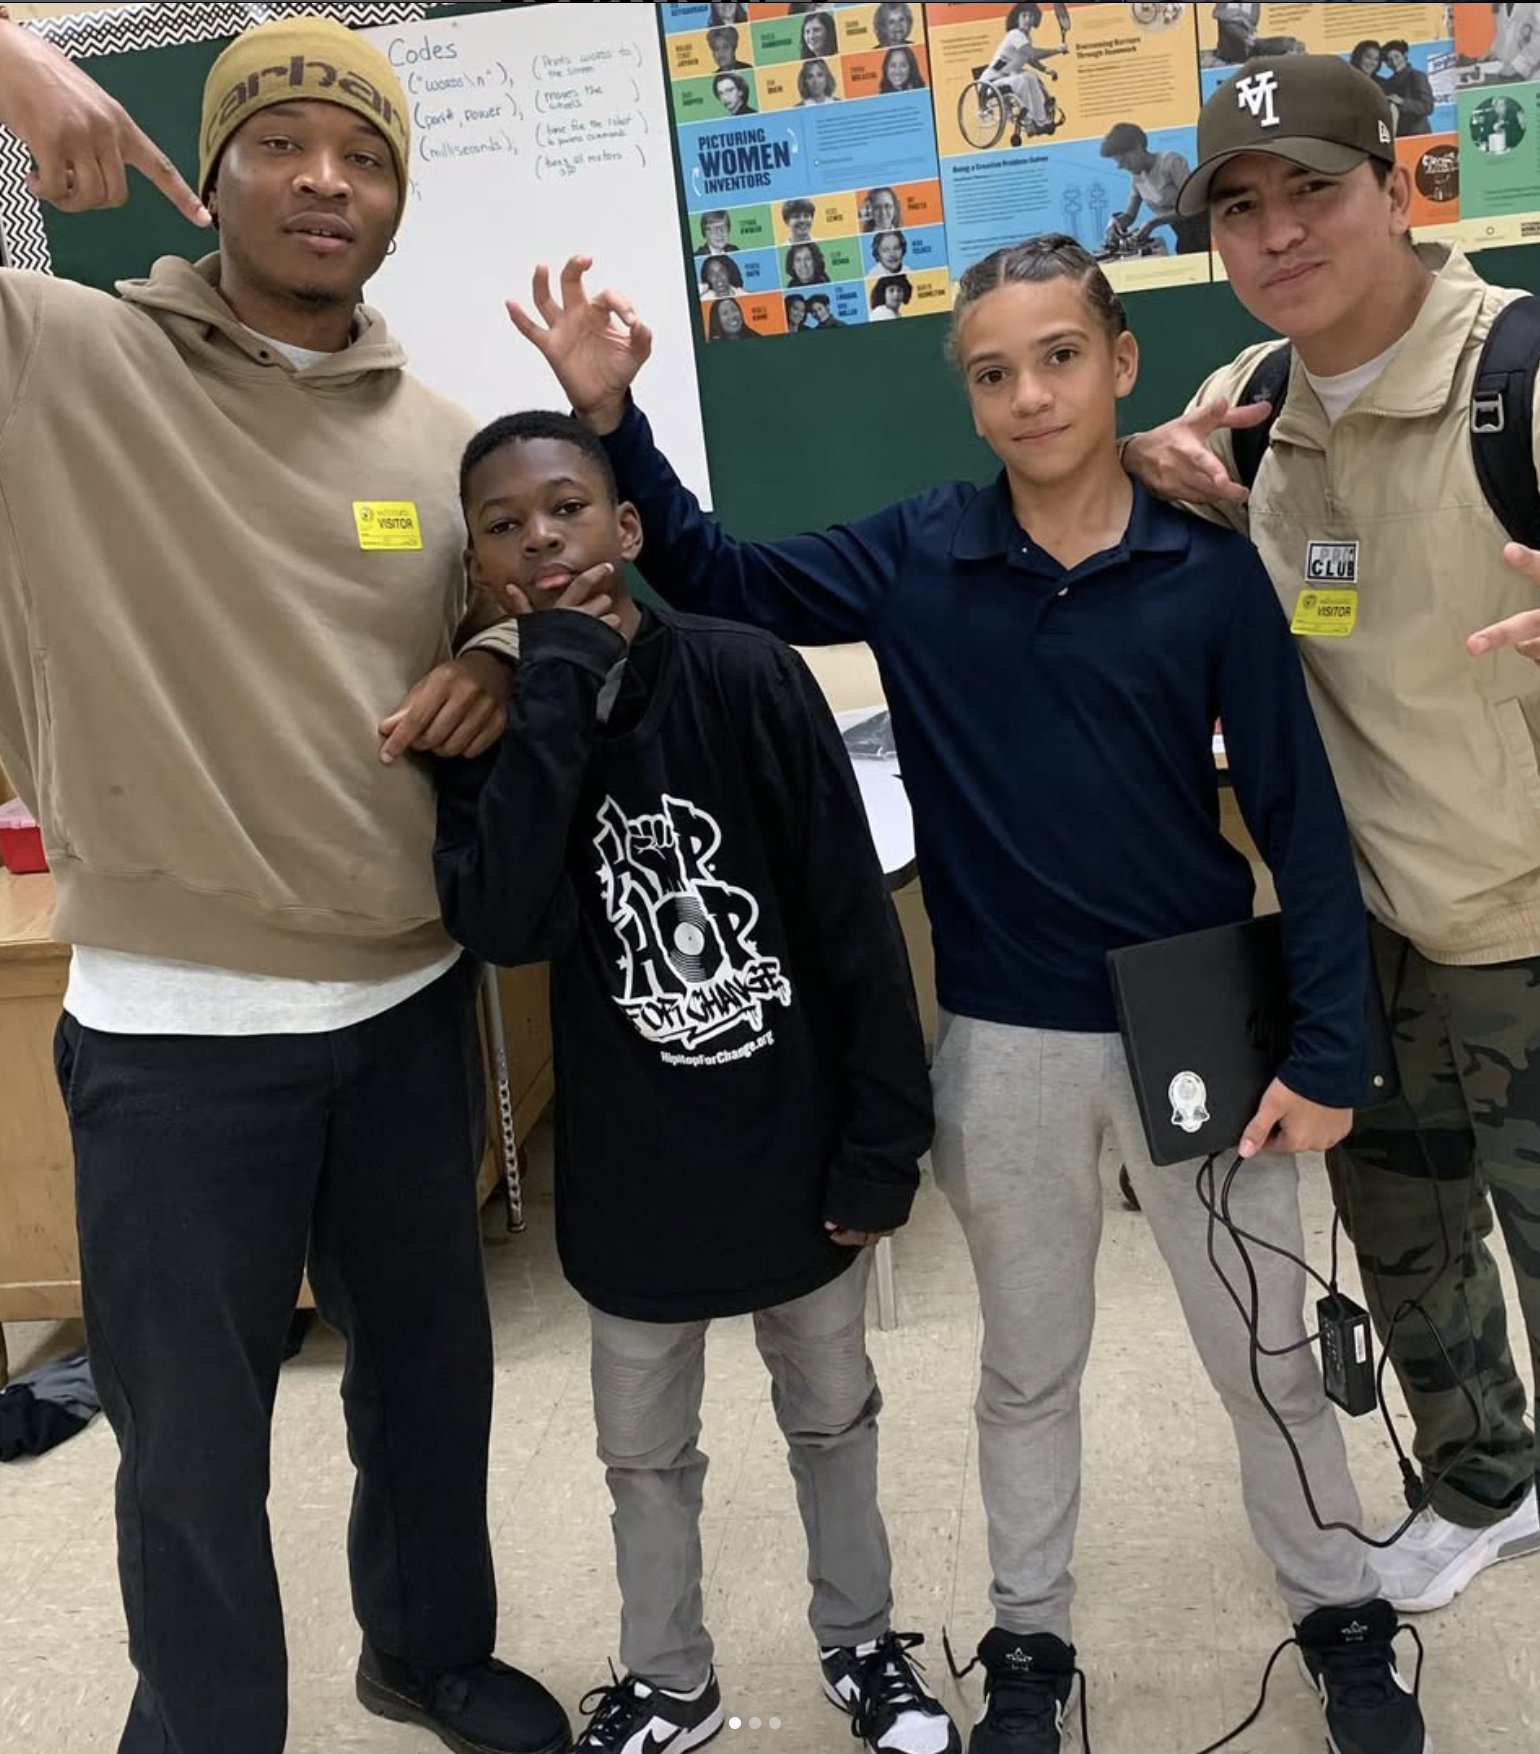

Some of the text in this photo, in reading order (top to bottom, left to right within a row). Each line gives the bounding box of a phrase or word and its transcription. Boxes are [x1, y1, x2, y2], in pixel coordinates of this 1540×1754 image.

[388, 35, 457, 67] Codes
[698, 128, 766, 151] PICTURING
[698, 141, 791, 178] WOMEN
[704, 172, 772, 194] INVENTORS
[377, 517, 414, 530] VISITOR
[1311, 559, 1355, 577] CLUB
[1317, 606, 1351, 618] VISITOR
